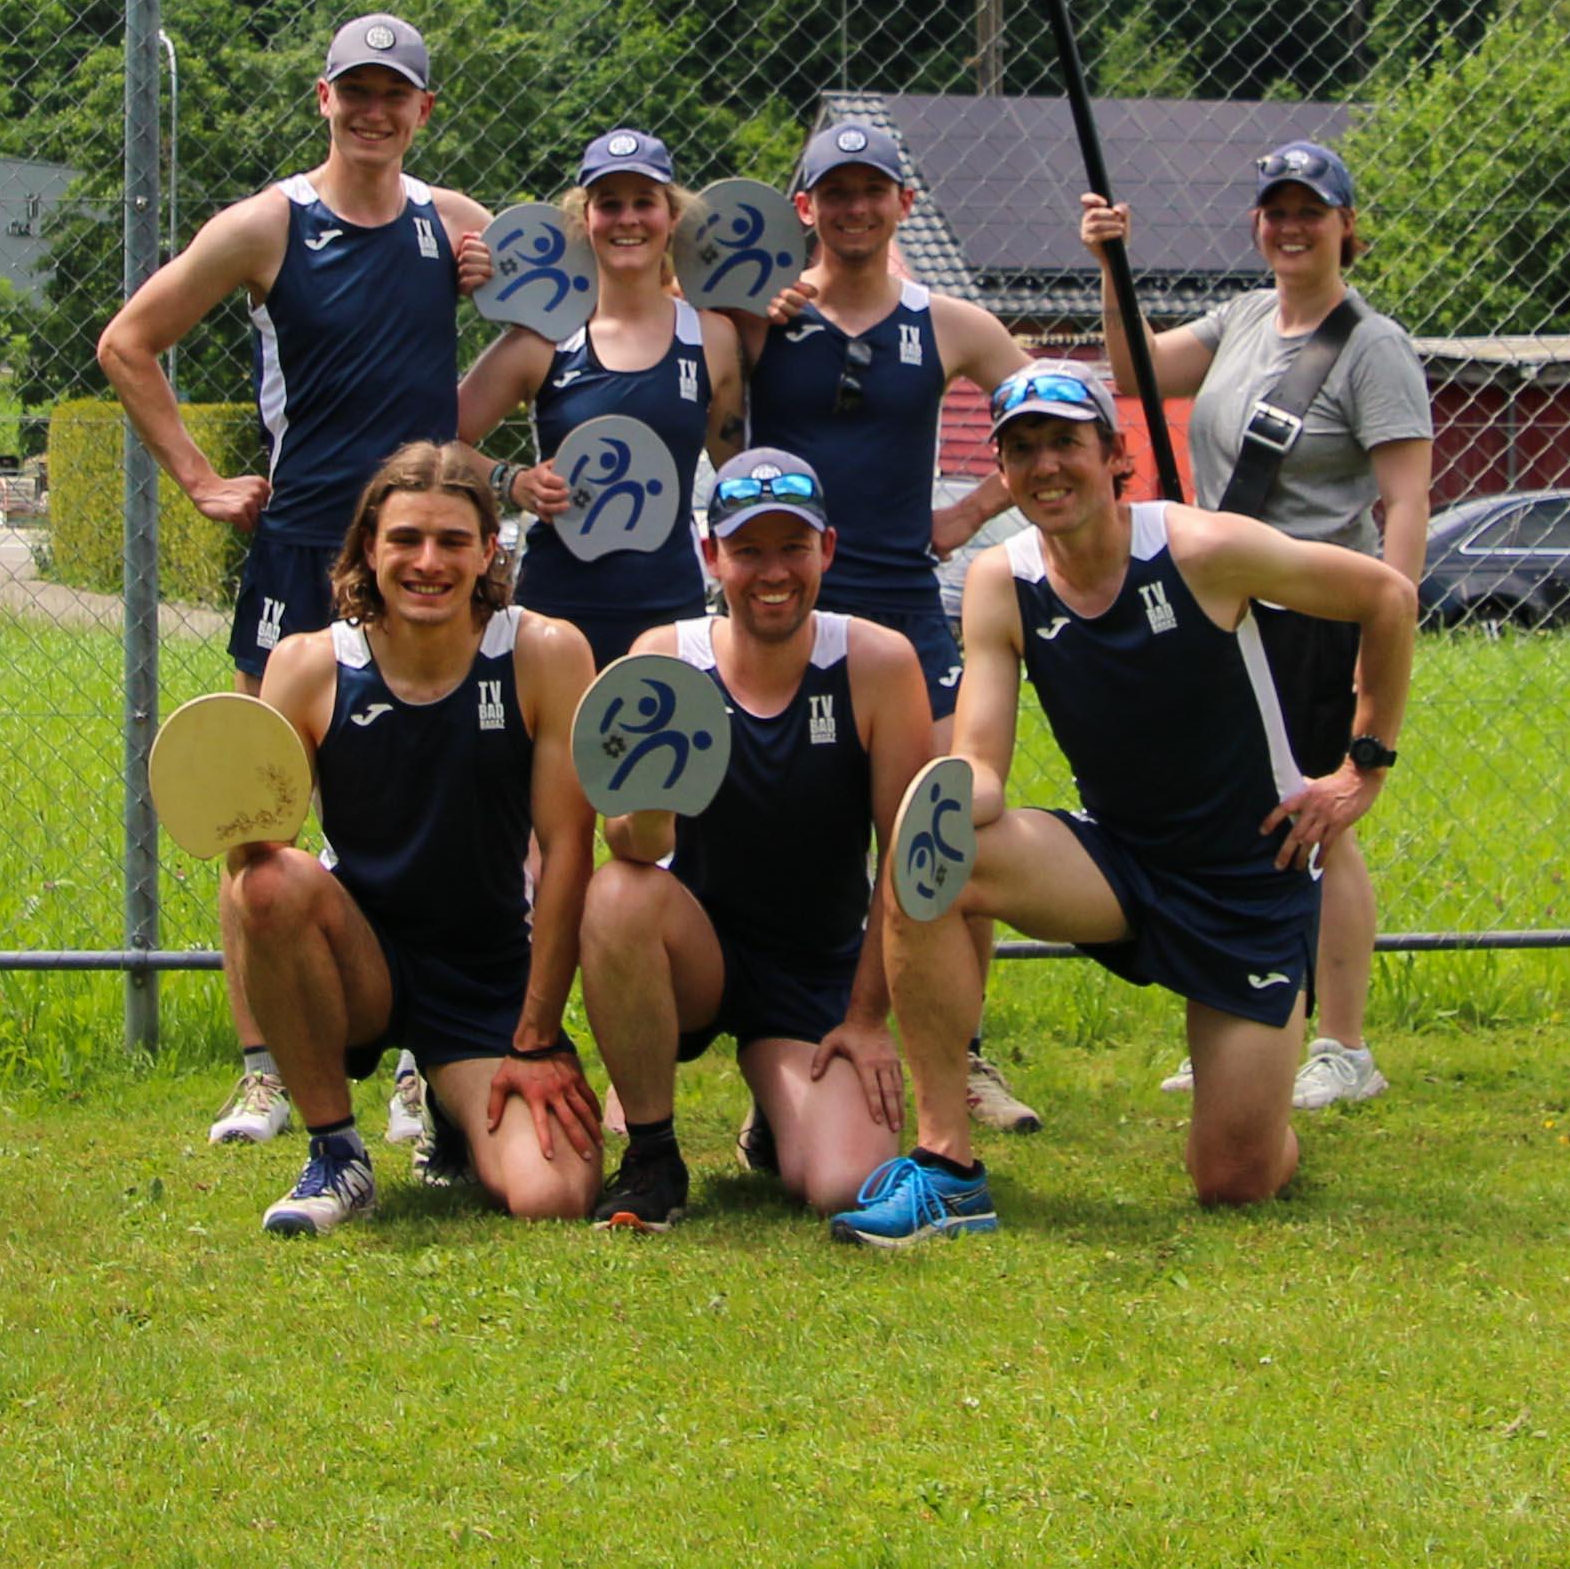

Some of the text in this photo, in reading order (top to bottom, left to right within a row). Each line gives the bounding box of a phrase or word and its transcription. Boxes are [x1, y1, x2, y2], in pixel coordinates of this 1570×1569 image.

[1138, 581, 1166, 608] TV
[262, 597, 285, 624] TV
[478, 680, 501, 703] TV
[479, 703, 504, 720] BAD
[809, 695, 833, 718] TV
